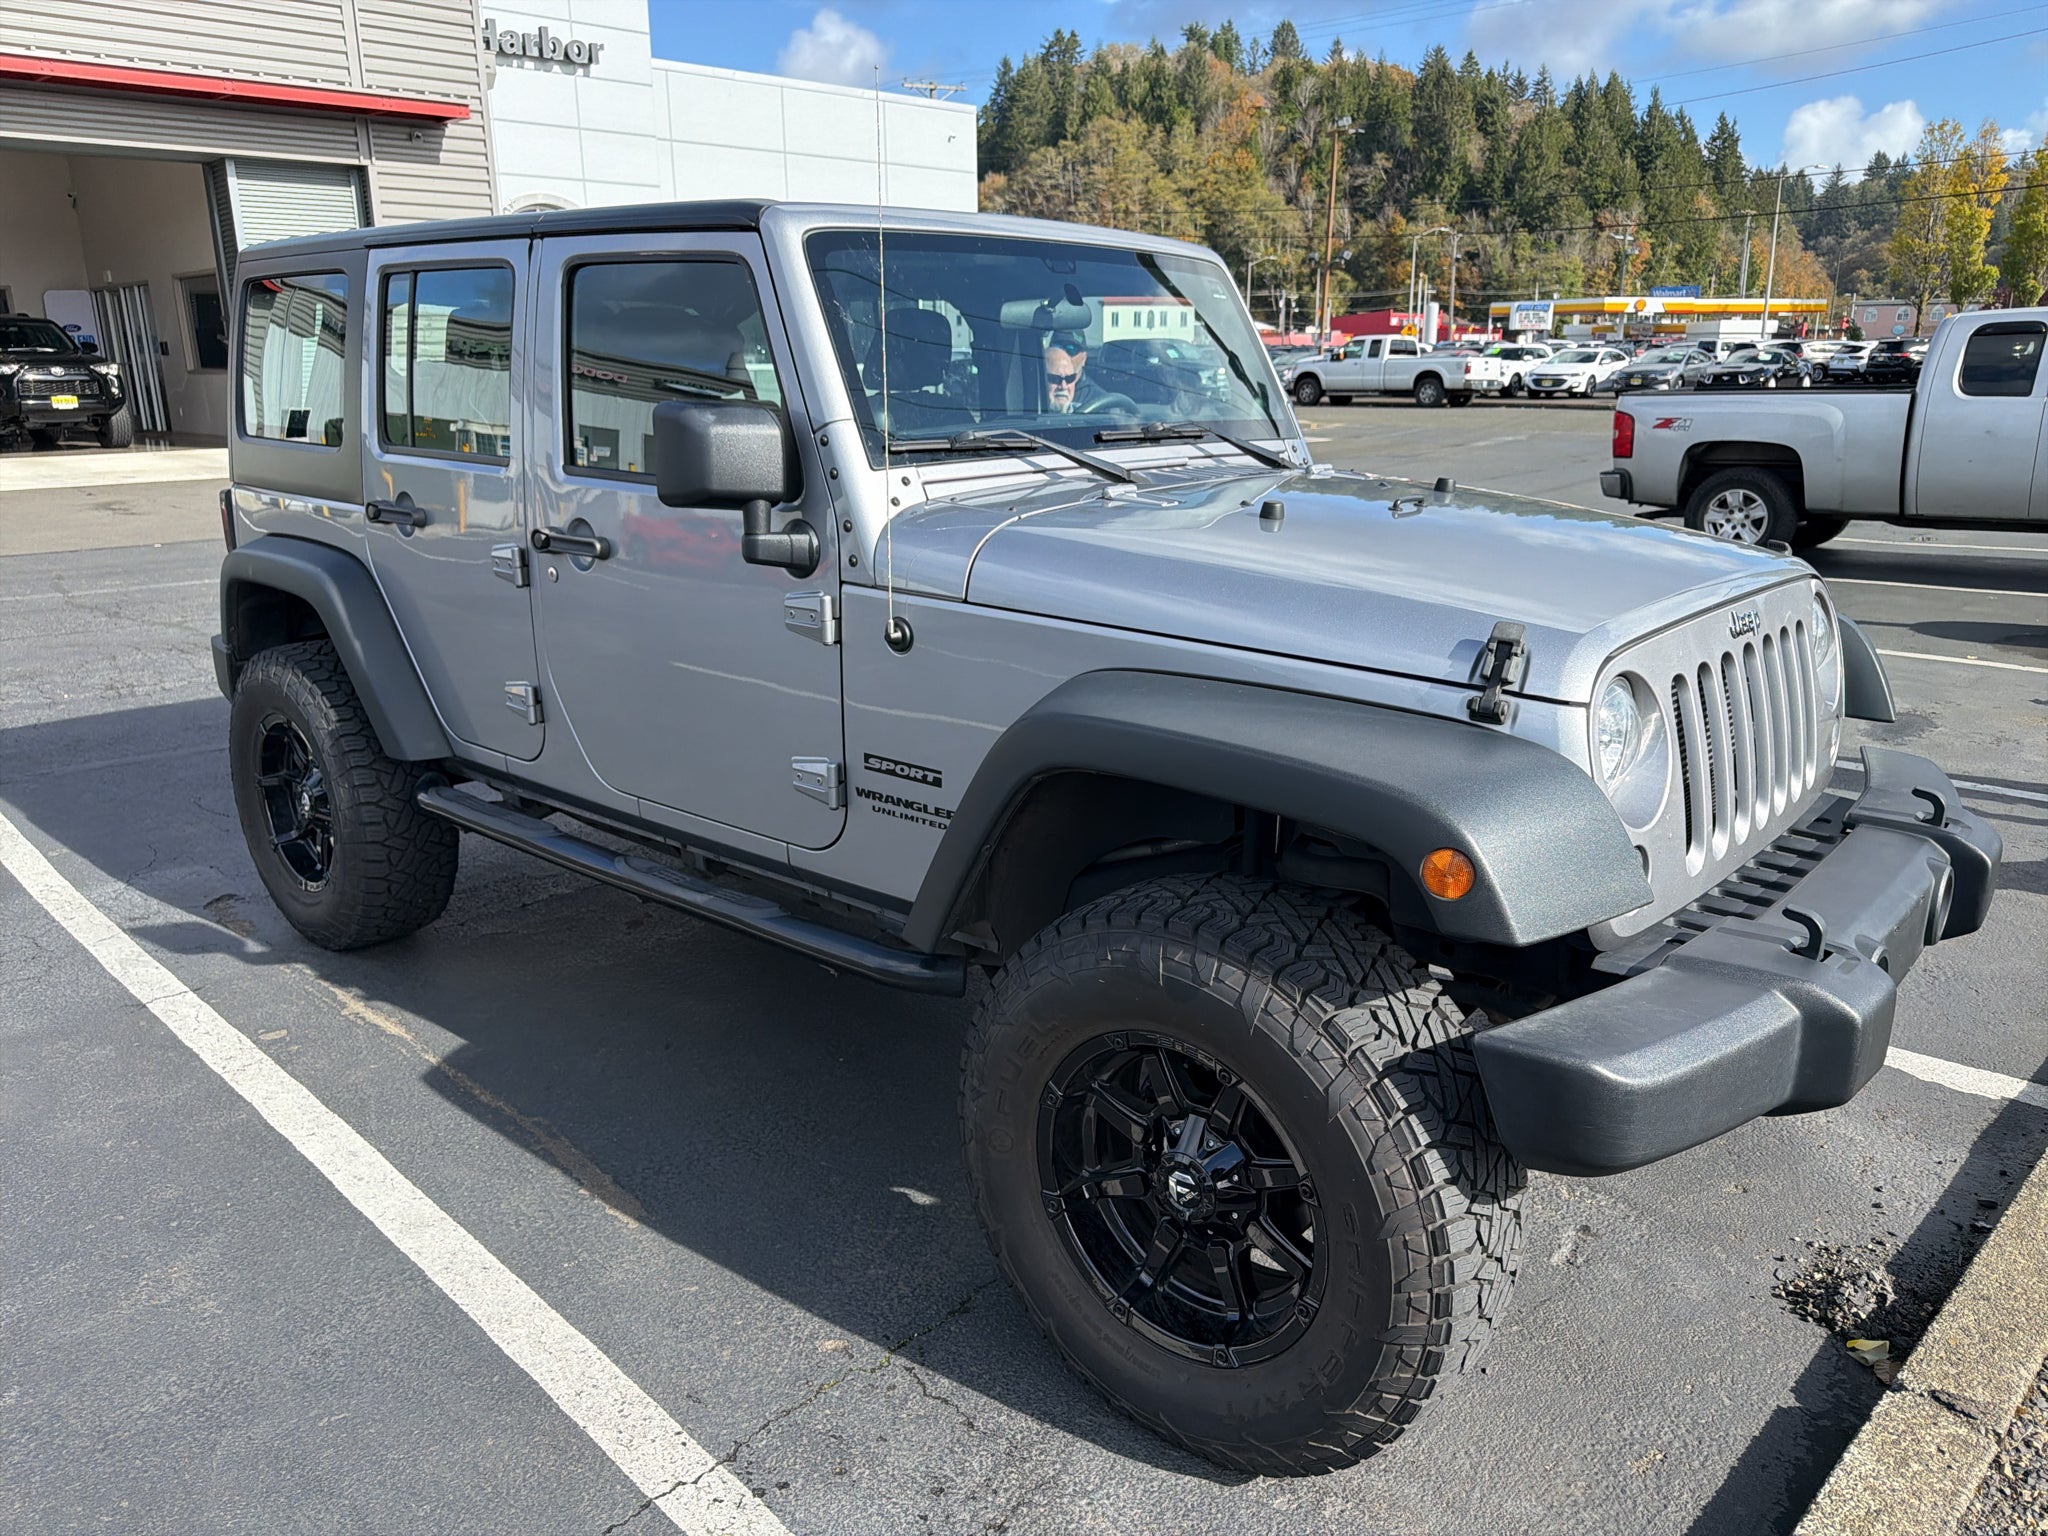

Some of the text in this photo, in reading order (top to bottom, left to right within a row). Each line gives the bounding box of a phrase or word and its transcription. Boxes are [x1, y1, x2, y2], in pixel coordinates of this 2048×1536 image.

[482, 18, 605, 65] Harbor
[1652, 288, 1687, 297] Walmart
[1727, 609, 1761, 640] Jeep
[865, 757, 942, 783] SPORT
[872, 805, 948, 830] UNLIMITED
[1178, 1191, 1199, 1205] FUEL
